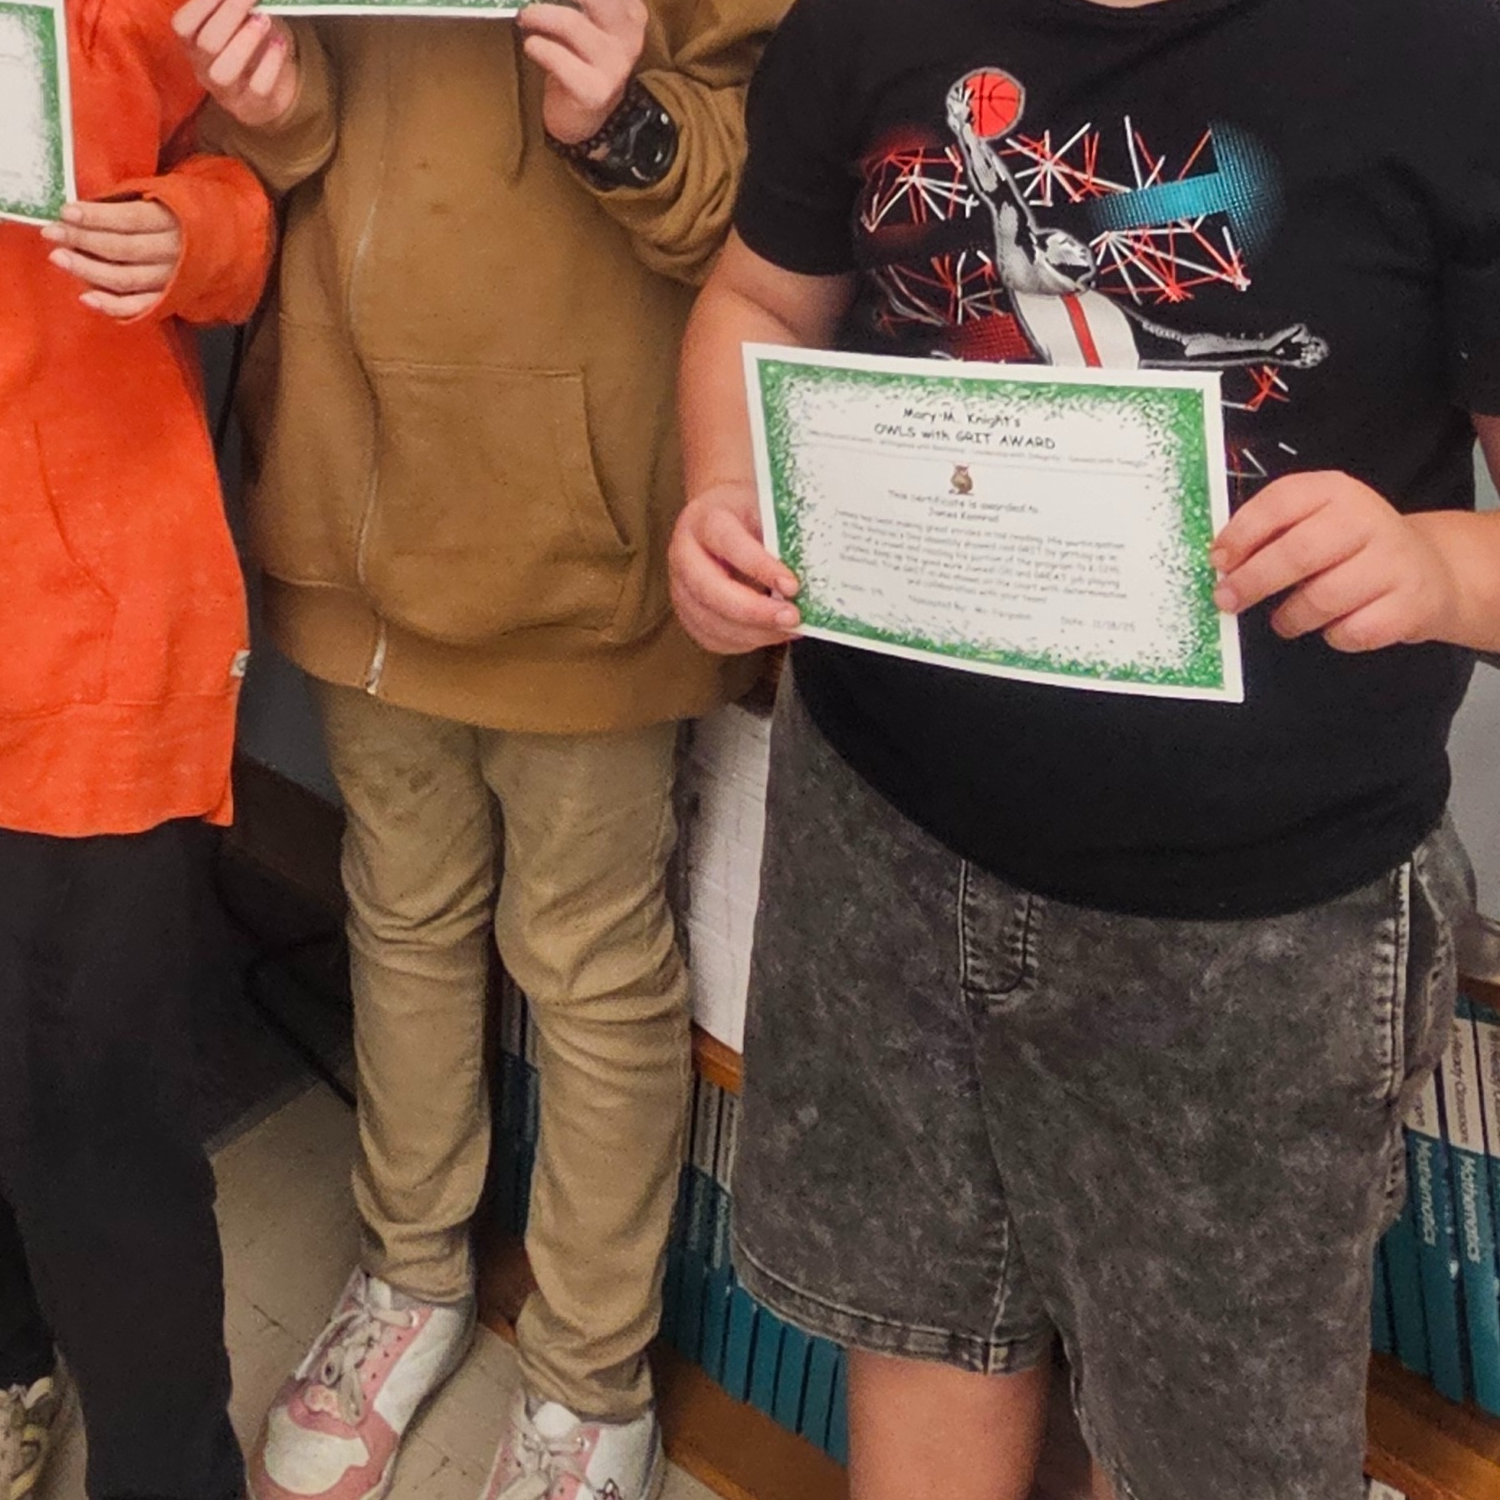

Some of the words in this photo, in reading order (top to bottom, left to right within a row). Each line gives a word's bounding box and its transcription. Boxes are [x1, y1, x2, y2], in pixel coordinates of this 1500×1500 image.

[902, 407, 936, 423] Mary
[966, 412, 1021, 430] Knight's
[873, 422, 916, 438] OWLS
[920, 427, 950, 441] with
[955, 429, 993, 444] GRIT
[998, 432, 1056, 450] AWARD
[910, 493, 965, 507] certificate
